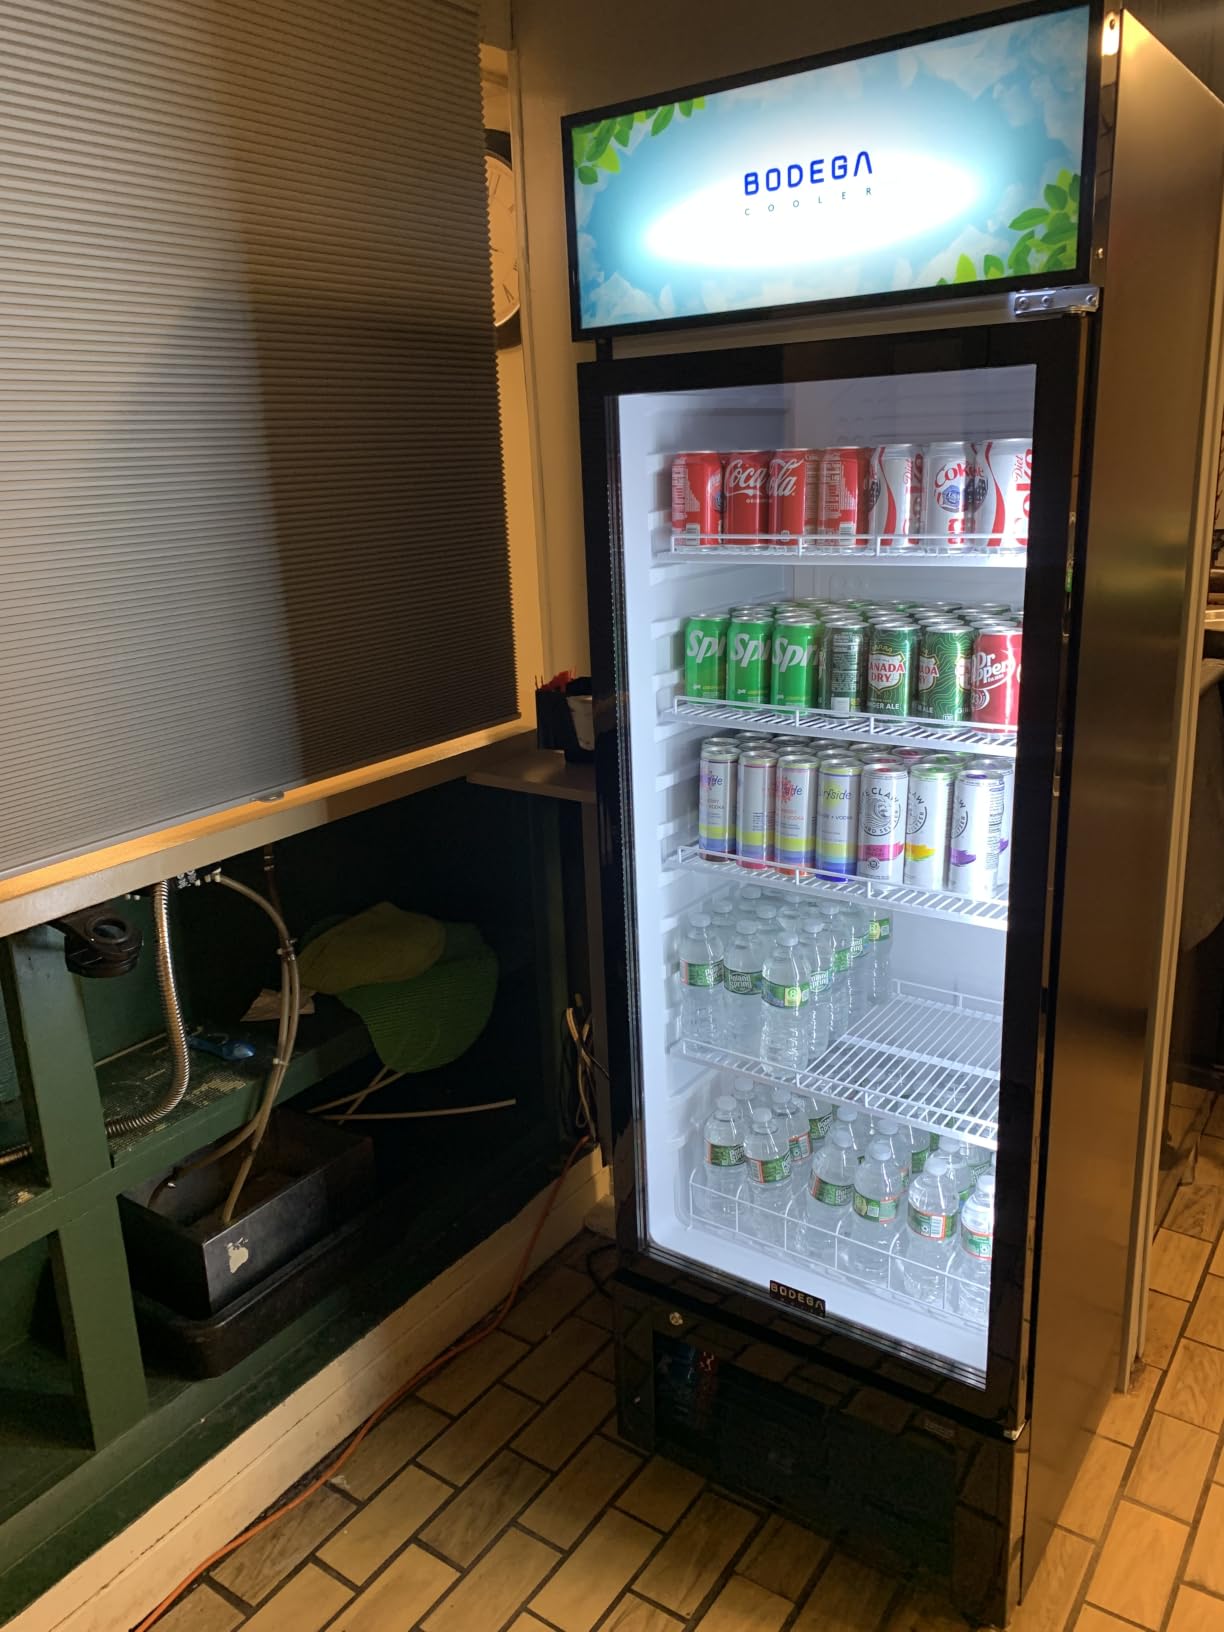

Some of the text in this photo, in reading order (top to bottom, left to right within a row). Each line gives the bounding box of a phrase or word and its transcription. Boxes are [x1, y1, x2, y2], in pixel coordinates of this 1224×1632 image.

[744, 150, 873, 196] BODEGA
[744, 187, 872, 216] COOLER
[724, 459, 767, 496] Coca
[976, 651, 997, 669] Dr
[771, 1283, 824, 1310] BODEGA
